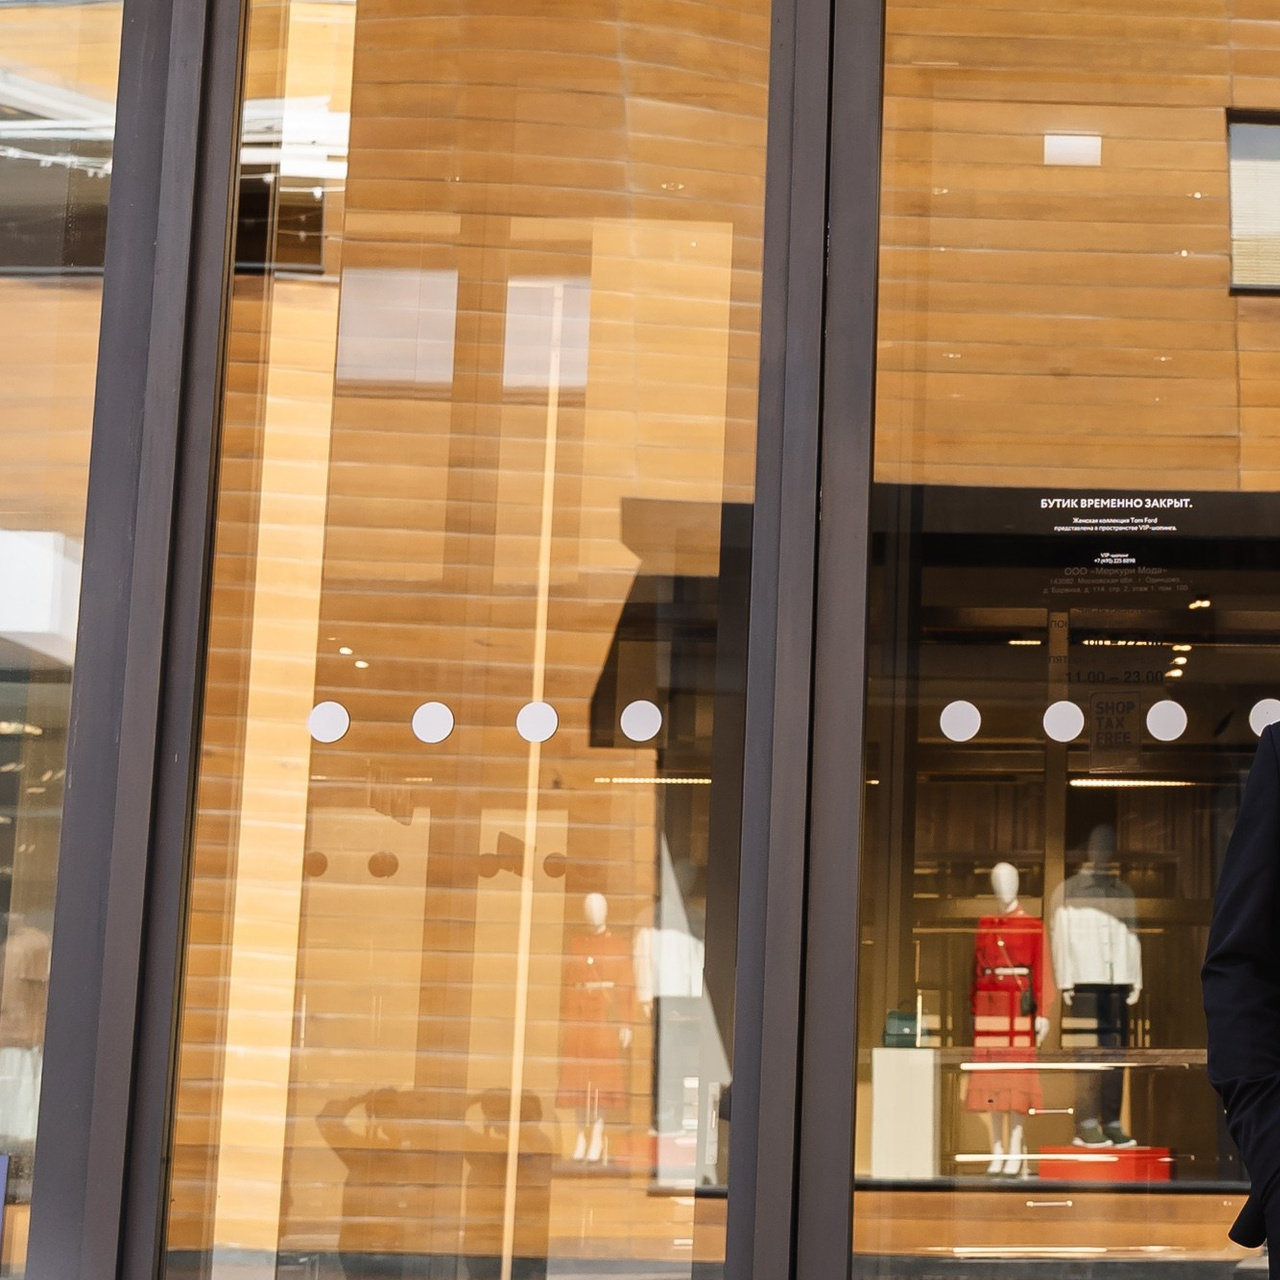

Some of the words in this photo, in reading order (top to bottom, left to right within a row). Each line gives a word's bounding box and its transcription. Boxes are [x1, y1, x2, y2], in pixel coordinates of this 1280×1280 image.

[1040, 498, 1079, 509] БУТИК
[1081, 498, 1143, 509] ВРЕМЕННО
[1145, 498, 1193, 509] ЗАКРЫТ.
[1130, 516, 1144, 524] Tom
[1144, 516, 1158, 524] Ford
[1064, 567, 1088, 576] ООО
[1095, 701, 1135, 715] SHOP
[1095, 716, 1125, 729] TAX
[1095, 731, 1132, 745] FREE
